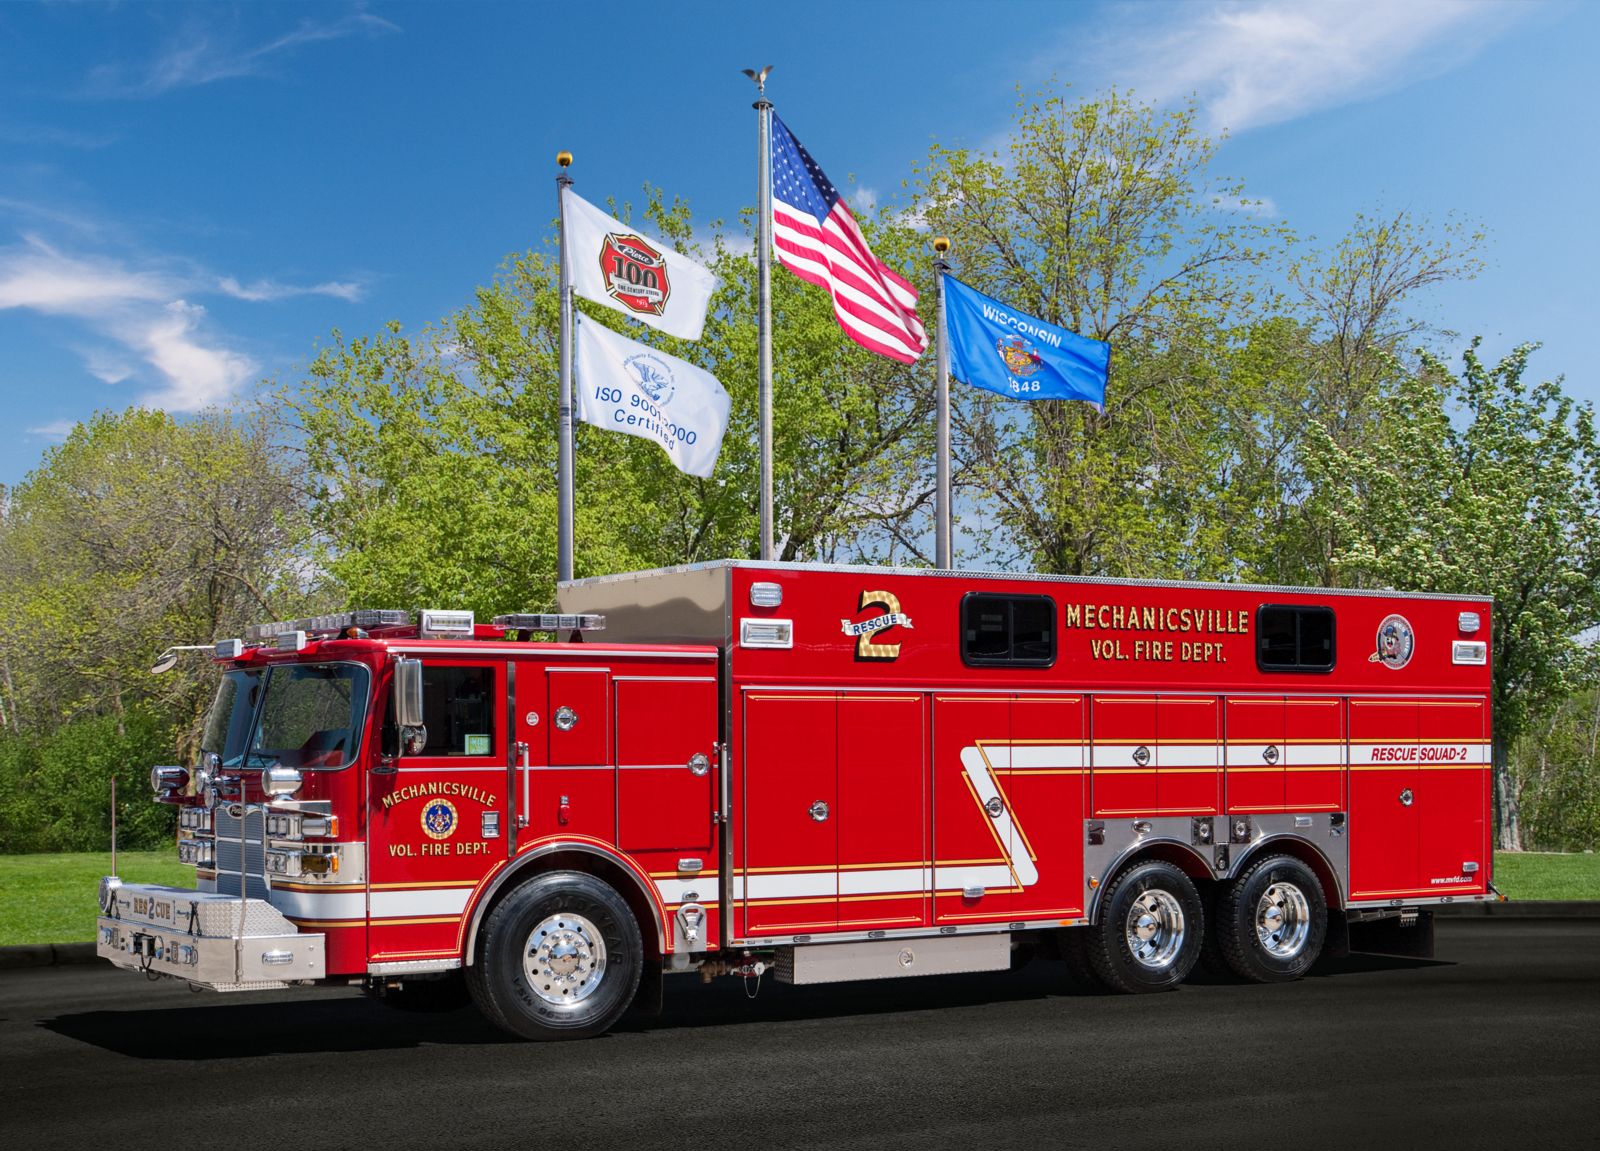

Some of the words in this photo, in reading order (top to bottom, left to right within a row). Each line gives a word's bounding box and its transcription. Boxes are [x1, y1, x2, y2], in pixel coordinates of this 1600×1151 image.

[622, 246, 651, 265] Pierce
[612, 256, 659, 290] 100
[983, 303, 1063, 348] WISCONSIN
[594, 386, 622, 403] ISO
[1008, 376, 1041, 393] 1848
[614, 409, 675, 450] Certified
[852, 613, 898, 635] RESCUE
[854, 589, 903, 663] 2
[1065, 603, 1249, 634] MECHANICSVILLE
[1091, 639, 1130, 660] VOL.
[1133, 640, 1174, 661] FIRE
[1180, 641, 1228, 662] DEPT.
[1371, 747, 1418, 761] RESCUE
[1419, 747, 1468, 761] SQUAD-2
[381, 781, 497, 809] MECHANICSVILLE
[389, 844, 417, 857] VOL.
[421, 843, 451, 856] FIRE
[456, 842, 491, 855] DEPT.
[133, 897, 148, 915] RES
[148, 896, 155, 920] 2
[155, 901, 171, 920] CUE
